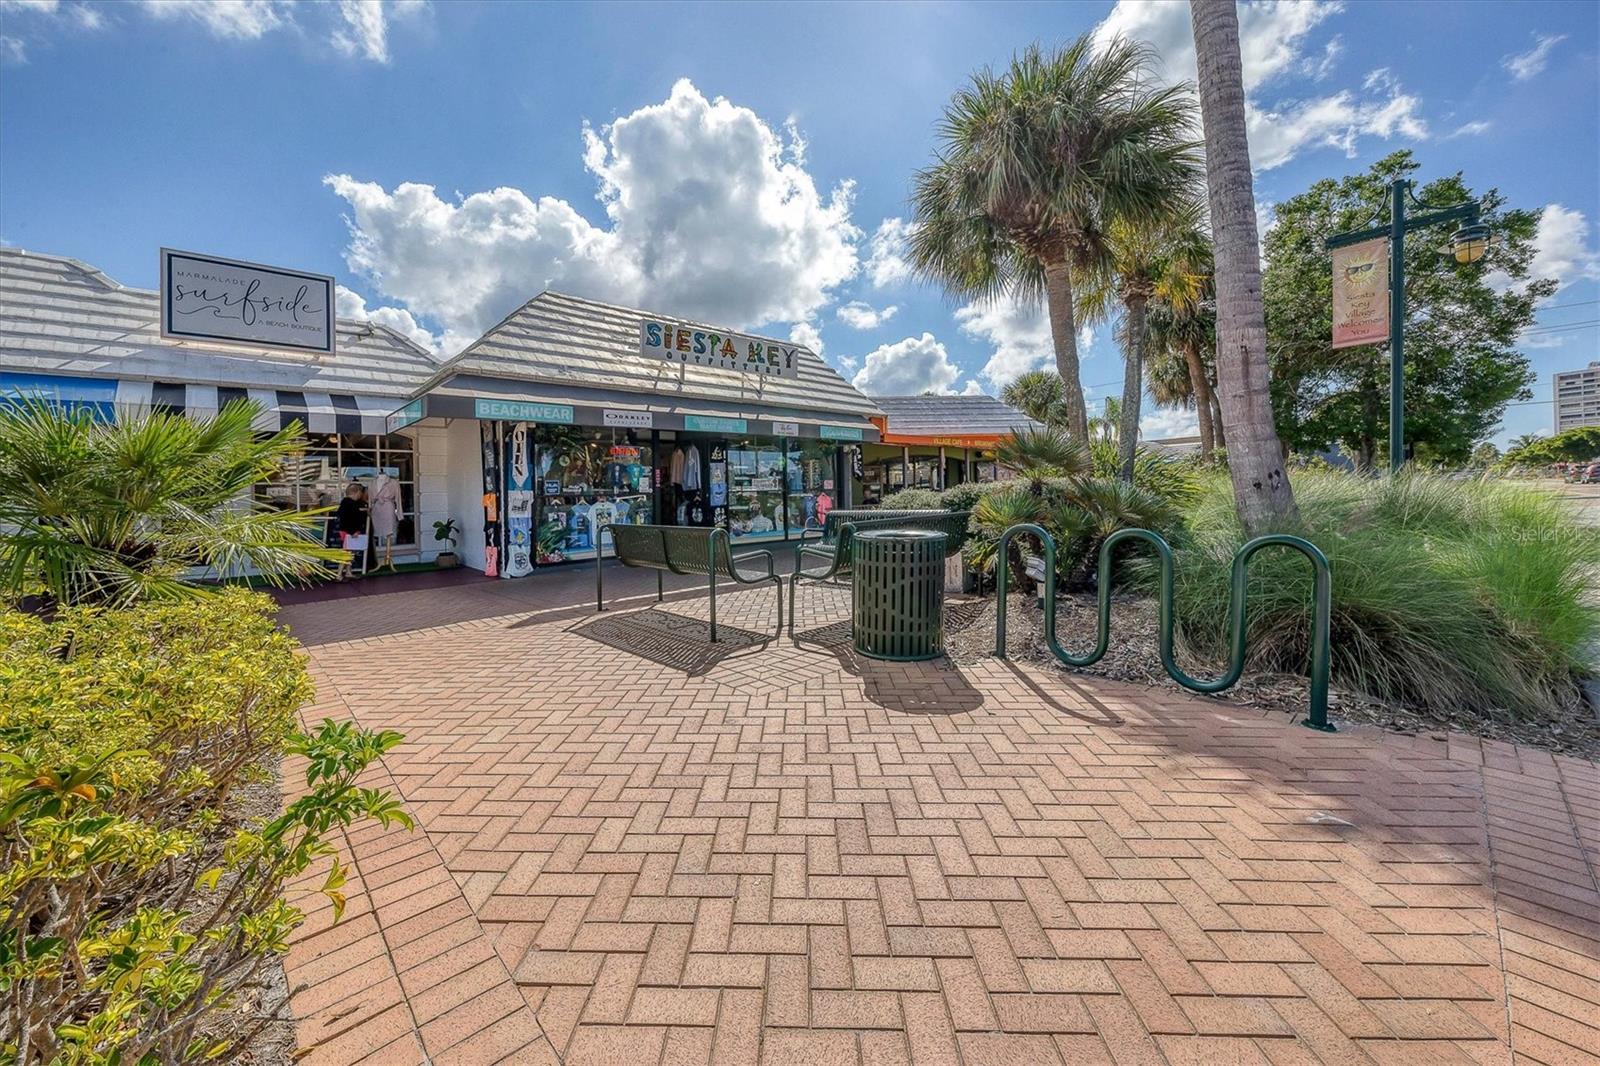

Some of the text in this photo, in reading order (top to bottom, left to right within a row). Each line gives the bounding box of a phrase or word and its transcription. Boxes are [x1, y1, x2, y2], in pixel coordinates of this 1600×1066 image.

[177, 271, 246, 286] MARMALADE
[175, 279, 323, 326] surfside
[291, 324, 322, 332] BOUTIQUE
[1337, 318, 1384, 329] Welcome
[666, 351, 781, 376] OUTFITTERS
[747, 341, 798, 369] KEY
[479, 402, 571, 420] BEACHWEAR
